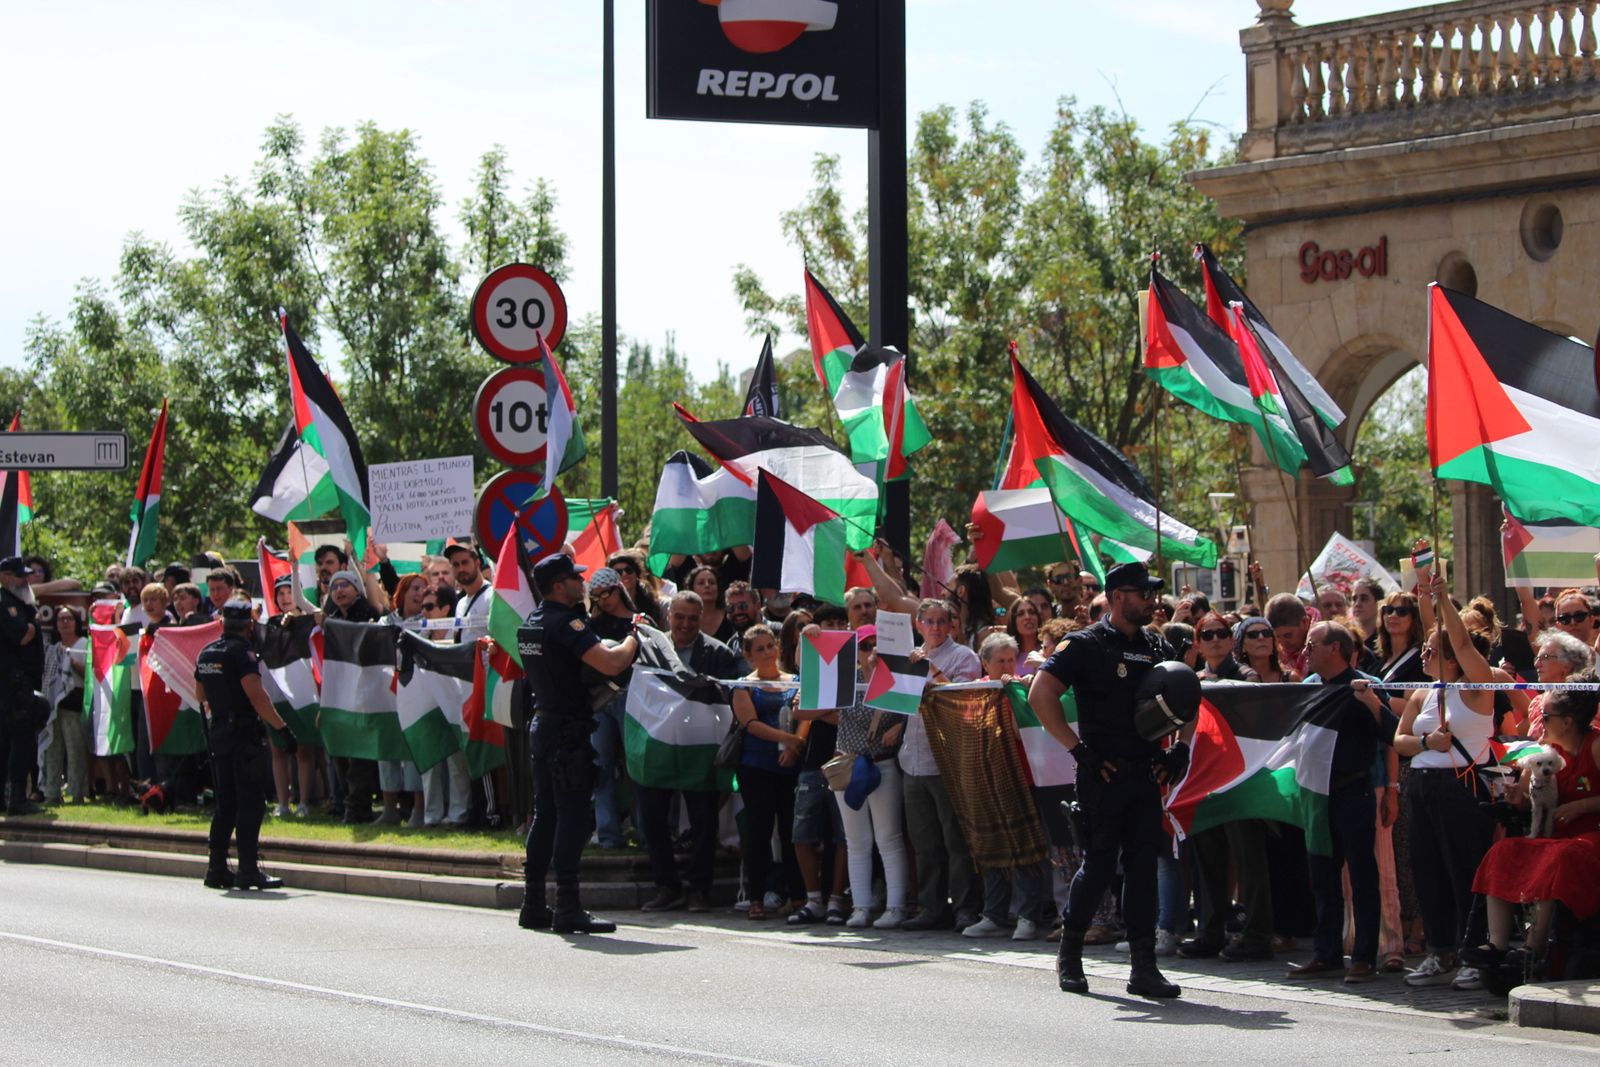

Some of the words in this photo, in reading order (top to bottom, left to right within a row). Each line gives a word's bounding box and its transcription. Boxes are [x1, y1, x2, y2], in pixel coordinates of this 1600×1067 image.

[697, 69, 839, 101] REPSOL
[496, 297, 546, 329] 30
[491, 401, 548, 433] 10t
[371, 464, 418, 481] MIENTRAS
[423, 464, 434, 473] EL
[438, 461, 470, 470] MUNDO
[373, 479, 400, 493] SIGUE
[403, 479, 443, 489] DORMIDO
[375, 513, 422, 535] PALESTINA
[1335, 542, 1367, 565] STOP
